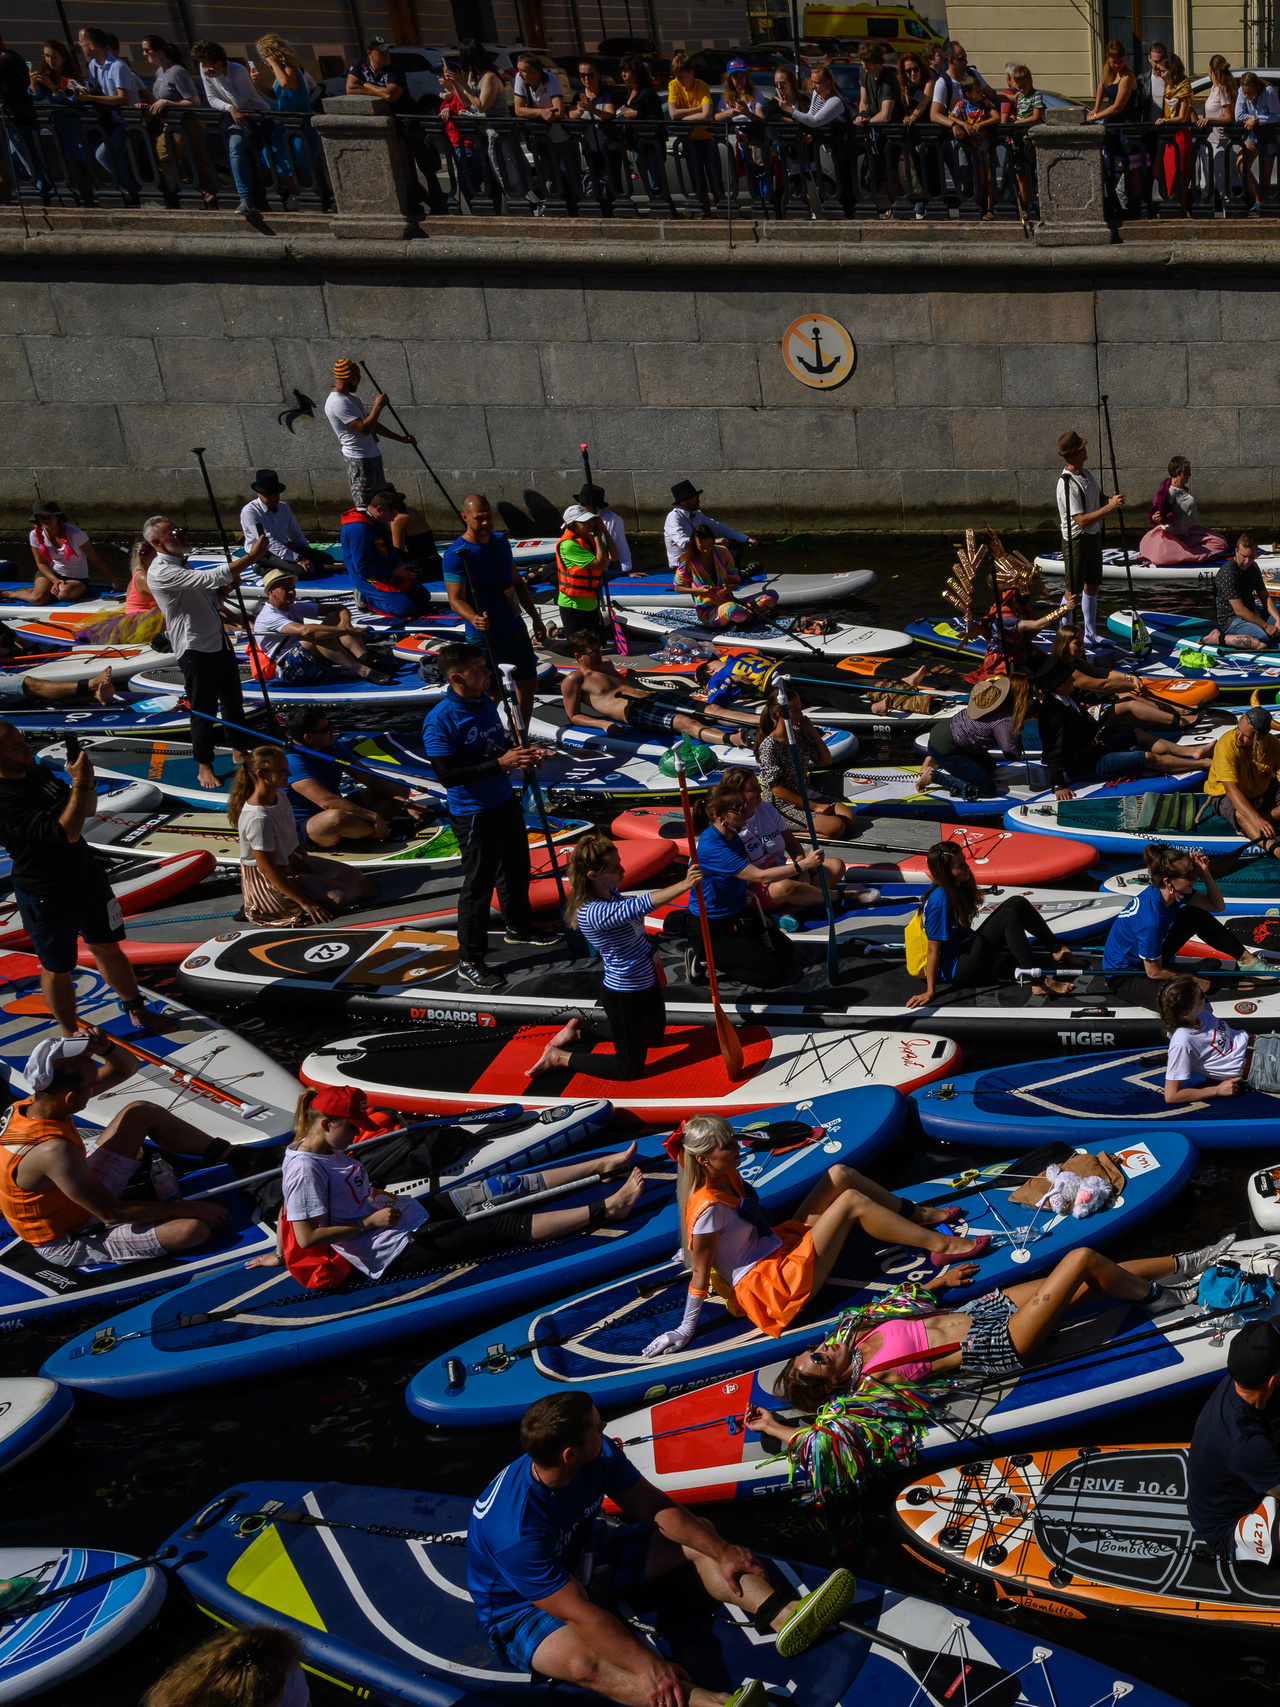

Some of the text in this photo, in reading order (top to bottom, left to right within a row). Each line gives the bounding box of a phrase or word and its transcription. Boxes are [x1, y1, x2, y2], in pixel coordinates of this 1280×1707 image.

[872, 724, 892, 734] PRO
[147, 759, 165, 781] SPORT
[308, 943, 342, 961] 22
[410, 1007, 478, 1023] D7BOARDS
[1057, 1031, 1117, 1047] TIGER
[1068, 1475, 1178, 1497] DRIVE 10.6
[1100, 1539, 1160, 1556] Bombitto
[1255, 1521, 1267, 1556] 0421
[1023, 1597, 1075, 1618] Bombitto
